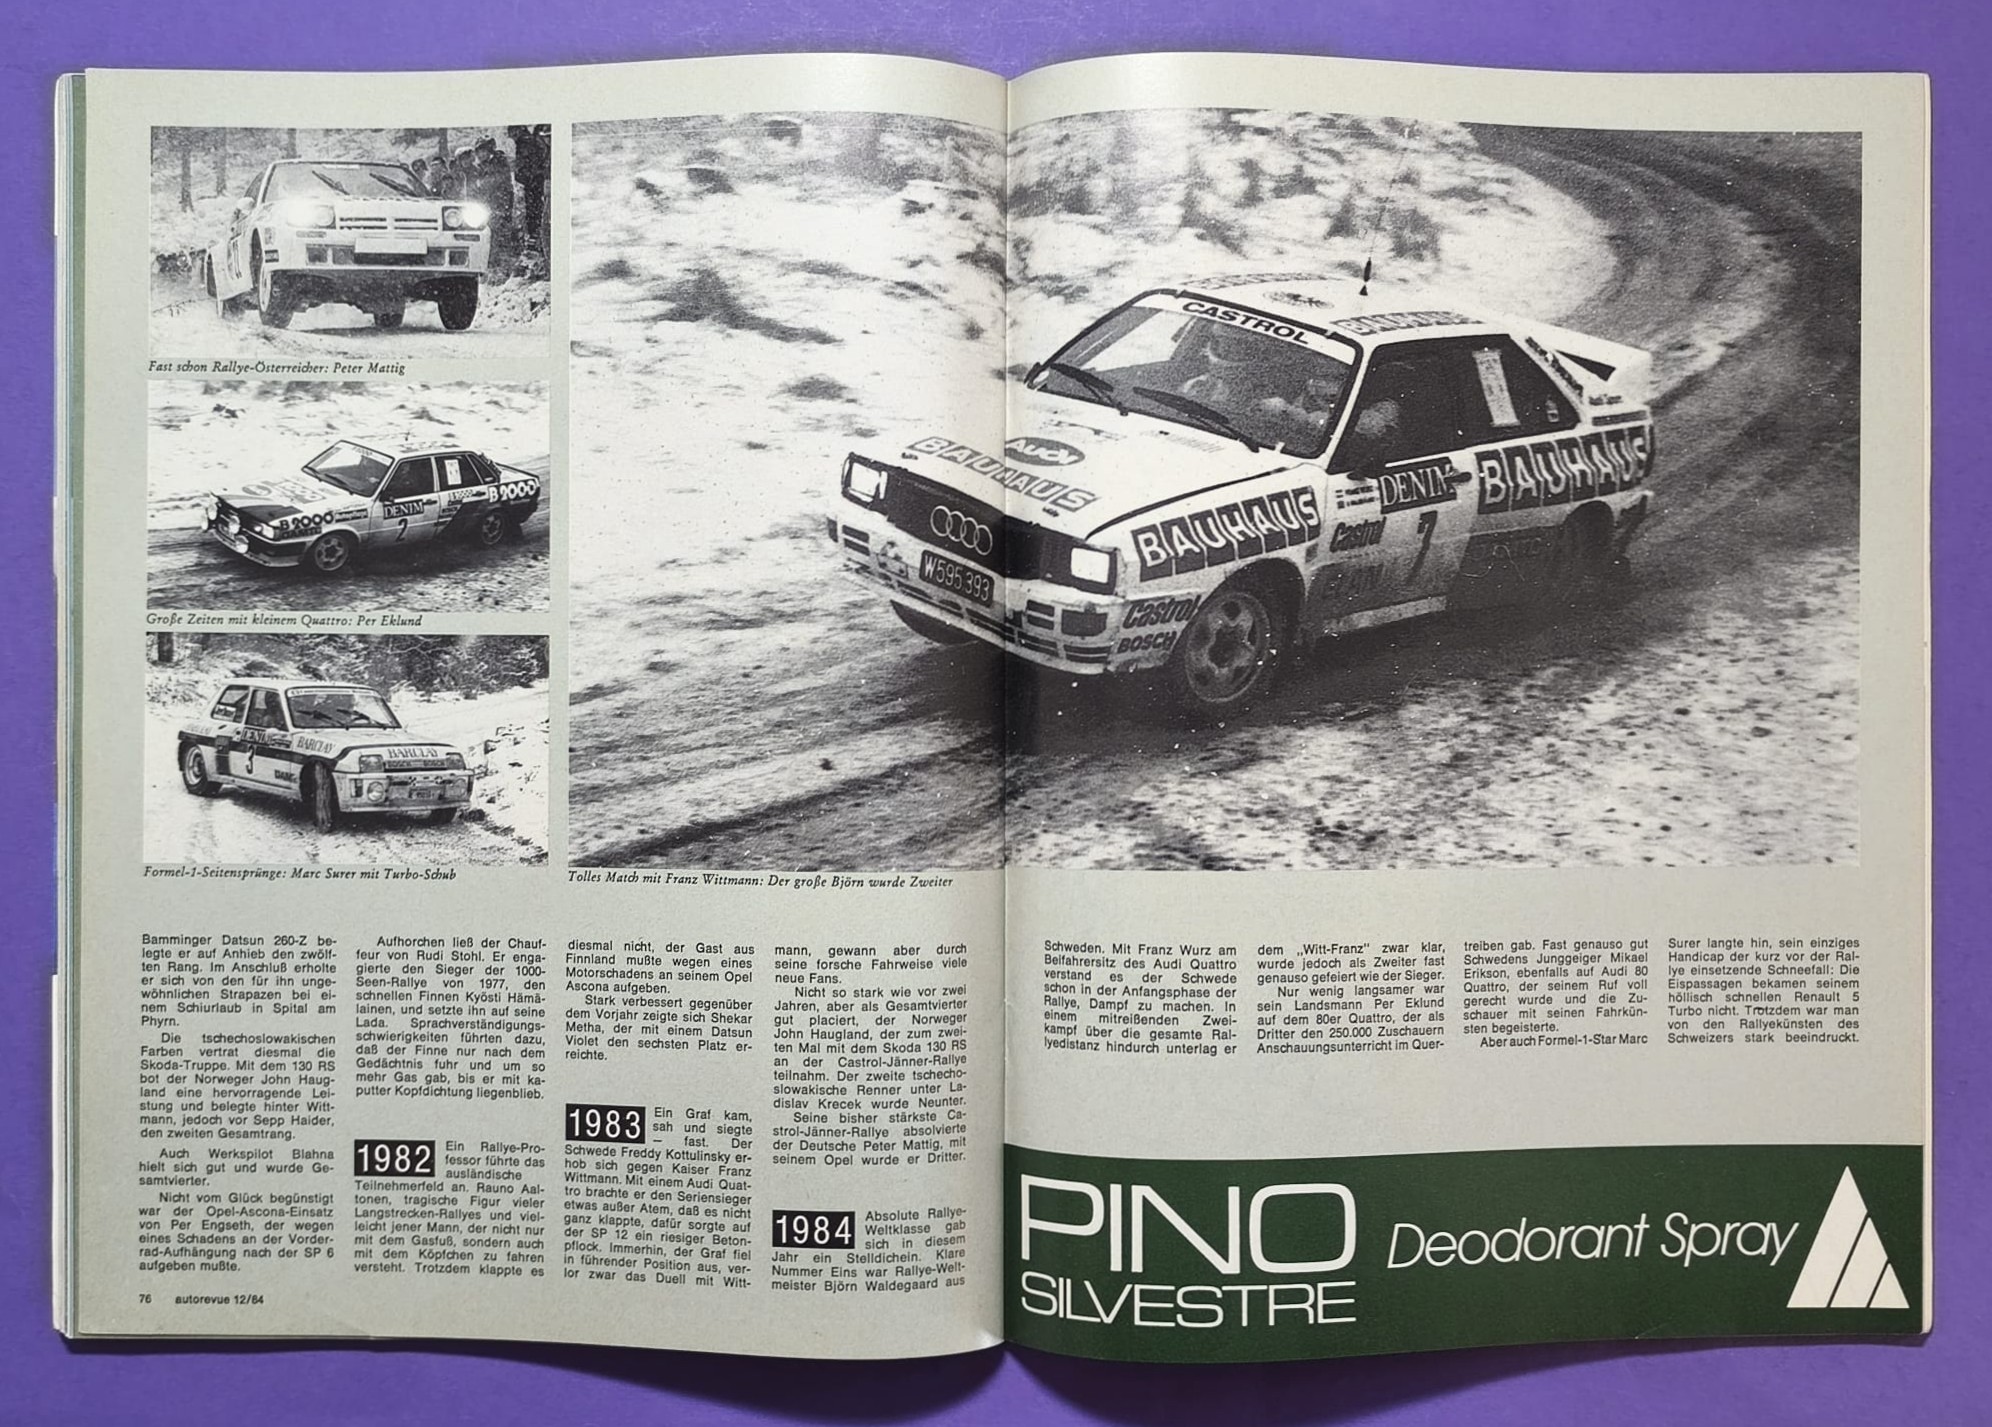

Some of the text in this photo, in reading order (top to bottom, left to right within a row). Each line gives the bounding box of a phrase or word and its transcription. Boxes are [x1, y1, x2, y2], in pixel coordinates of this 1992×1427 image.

[1182, 301, 1310, 345] CASTROL
[148, 361, 406, 376] Fast schon Rallye-Österreicher: Peter Mattig
[911, 437, 1097, 512] BAUHAUS
[1480, 437, 1648, 505] BAUHAUS
[383, 500, 425, 519] DENIM
[395, 518, 409, 542] 2
[1137, 492, 1321, 567] BAUHAUS
[1404, 510, 1439, 587] 7
[1122, 595, 1203, 629] Castrol
[145, 613, 423, 629] Große Zeiten mit kleinem Quattro: Per Eklund
[1117, 630, 1178, 654] BOSCH
[296, 735, 336, 755] BARCLAY
[386, 747, 440, 759] BARCLAY
[142, 866, 457, 882] Formel-1-Seitensprünge: Marc Surer mit Turbo-Schub
[568, 871, 954, 890] Tolles Match mit Franz Wittmann: Der große Björn wurde Zweiter
[141, 933, 338, 948] Bamminger Datsun 260-Z be-
[376, 935, 547, 950] Aufhorchen ließ der Chauf-
[567, 939, 755, 955] diesmal nicht, der Gast aus
[774, 943, 968, 959] mann, gewann aber durch
[1463, 951, 1648, 967] Schwedens Junggeiger Mikael
[565, 966, 753, 985] Motorschadens an seinem Opel
[1043, 969, 1238, 985] verstand es der Schwede
[1667, 977, 1860, 992] Eispassagen bekamen seinem
[355, 989, 546, 1005] schnellen Finnen Kyösti Hämä-
[1256, 996, 1445, 1012] sein Landsmann Per Eklund
[1668, 990, 1860, 1003] höllisch schnellen Renault 5
[1043, 1010, 1238, 1027] einem mitreißenden Zwei-
[1463, 1005, 1648, 1021] schauer mit seinen Fahrkün-
[355, 1016, 546, 1034] Lada. Sprachverständigungs-
[1256, 1025, 1445, 1040] Dritter den 250.000 Zuschauern
[160, 1032, 336, 1045] Die tschechoslowakischen
[1667, 1031, 1860, 1044] Schweizers stark beeindruckt.
[1044, 1037, 1238, 1057] lyedistanz hindurch unterlag er
[773, 1053, 967, 1068] an der Castrol-Jänner-Rallye
[654, 1106, 753, 1123] Ein Graf kam,
[570, 1109, 640, 1138] 1983
[445, 1140, 546, 1156] Ein Rallye-Pro-
[358, 1144, 430, 1172] 1982
[159, 1191, 334, 1206] Nicht vom Glück begünstigt
[138, 1205, 334, 1219] war der Opel-Ascona-Einsatz
[354, 1206, 545, 1223] Langstrecken-Rallyes und viel-
[864, 1206, 967, 1222] Absolute Rallye-
[777, 1215, 851, 1244] 1984
[1020, 1173, 1357, 1275] PINO
[1387, 1211, 1801, 1270] Deodorant Spray
[771, 1276, 966, 1294] meister Björn Waldegaard aus
[138, 1293, 264, 1305] 76 autorevue 12/84
[1020, 1271, 1358, 1328] SILVESTRE
